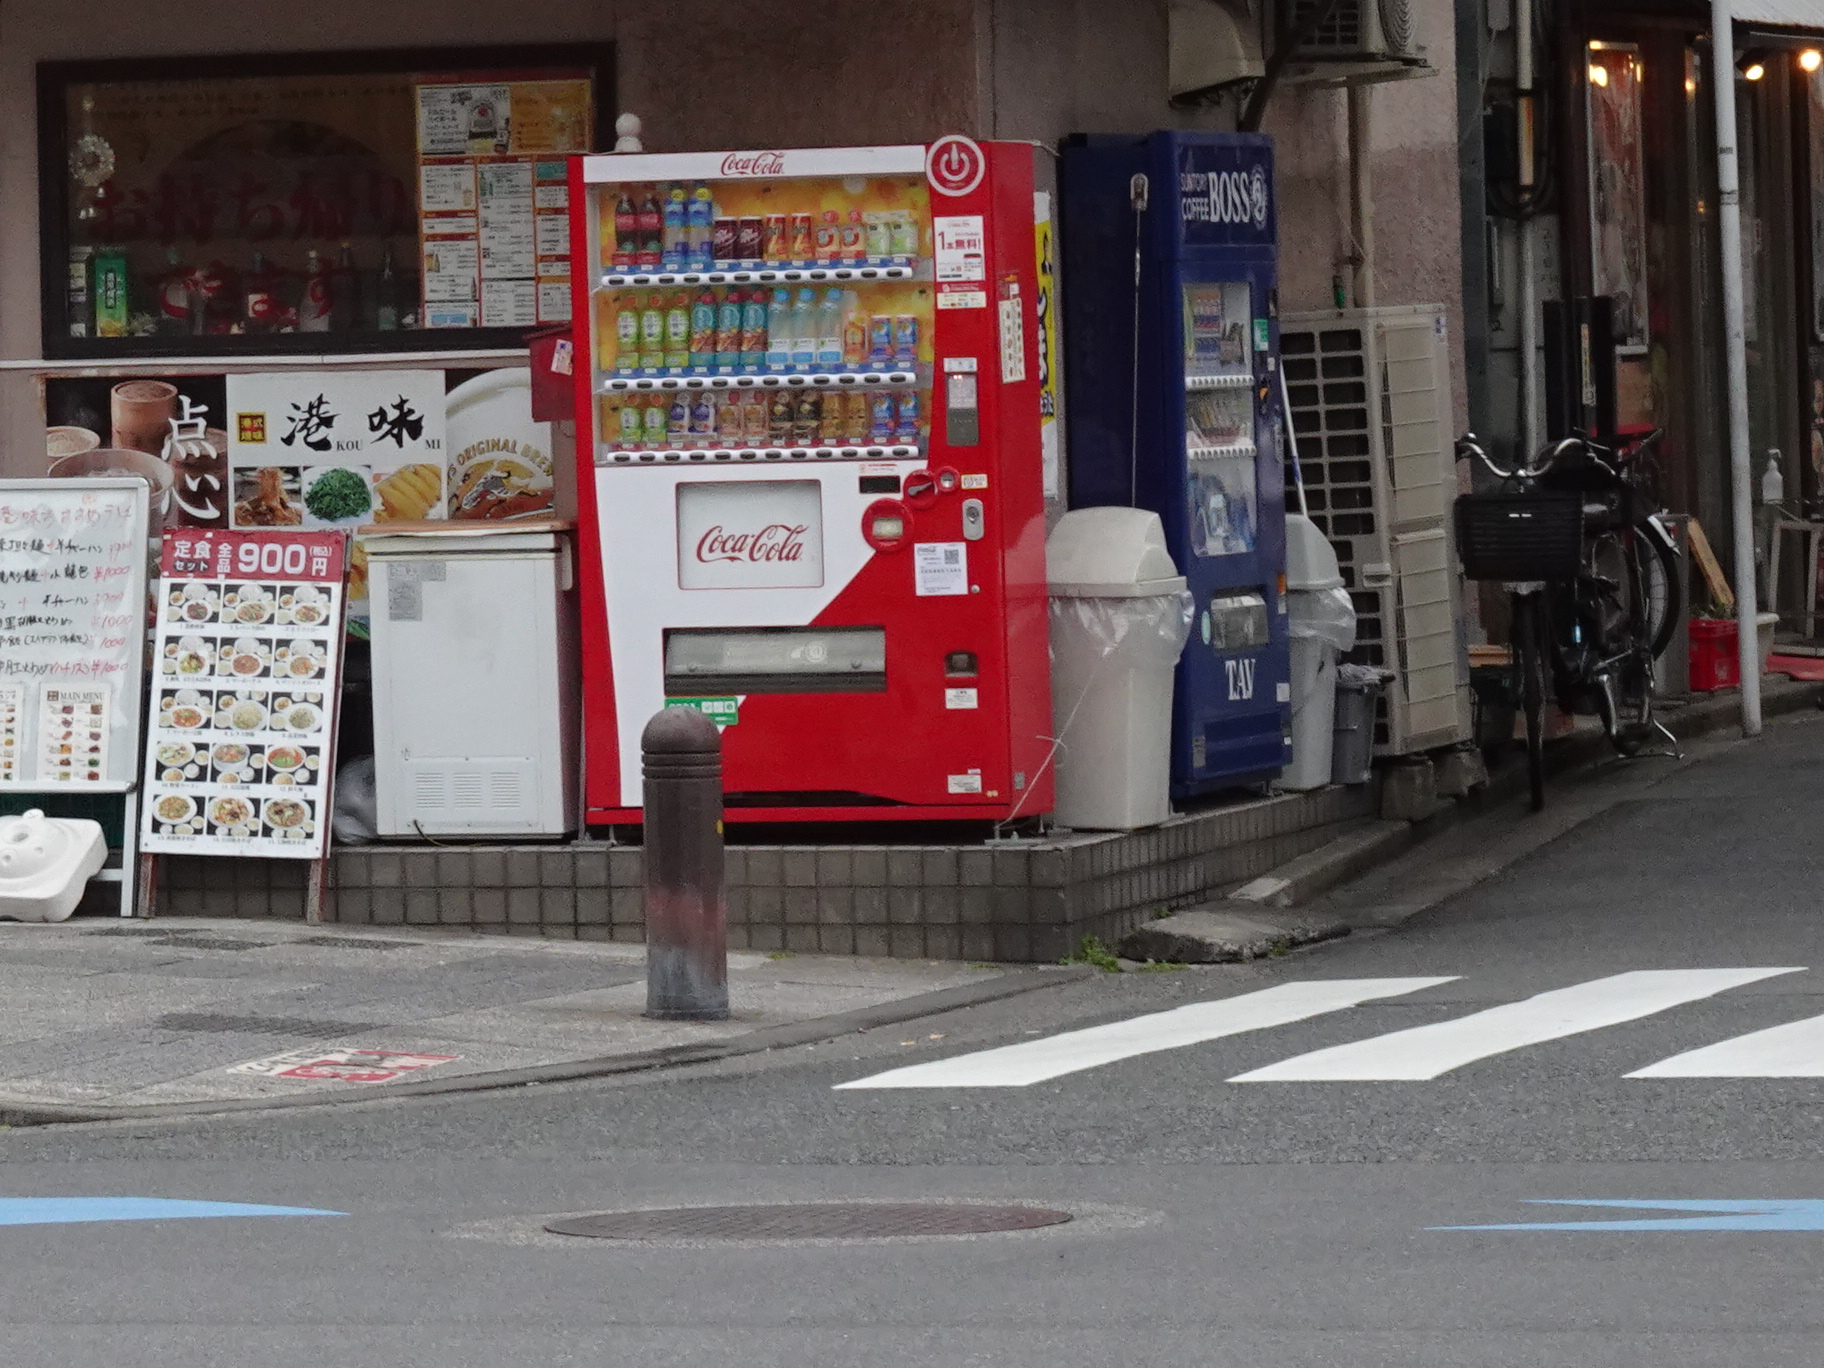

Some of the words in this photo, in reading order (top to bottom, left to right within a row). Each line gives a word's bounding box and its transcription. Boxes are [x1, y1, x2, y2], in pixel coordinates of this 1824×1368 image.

[721, 152, 785, 178] Coca-Cola
[1181, 197, 1209, 221] COFFEE
[1208, 171, 1250, 223] BOSS
[336, 439, 362, 451] KOU
[425, 439, 441, 449] MI
[457, 436, 517, 466] ORIGINAL
[161, 394, 222, 520] 点心
[174, 540, 212, 559] 定食
[696, 524, 810, 563] Coca-Cola
[175, 560, 208, 572] セット
[217, 542, 233, 573] 全品
[61, 691, 81, 701] MAIN
